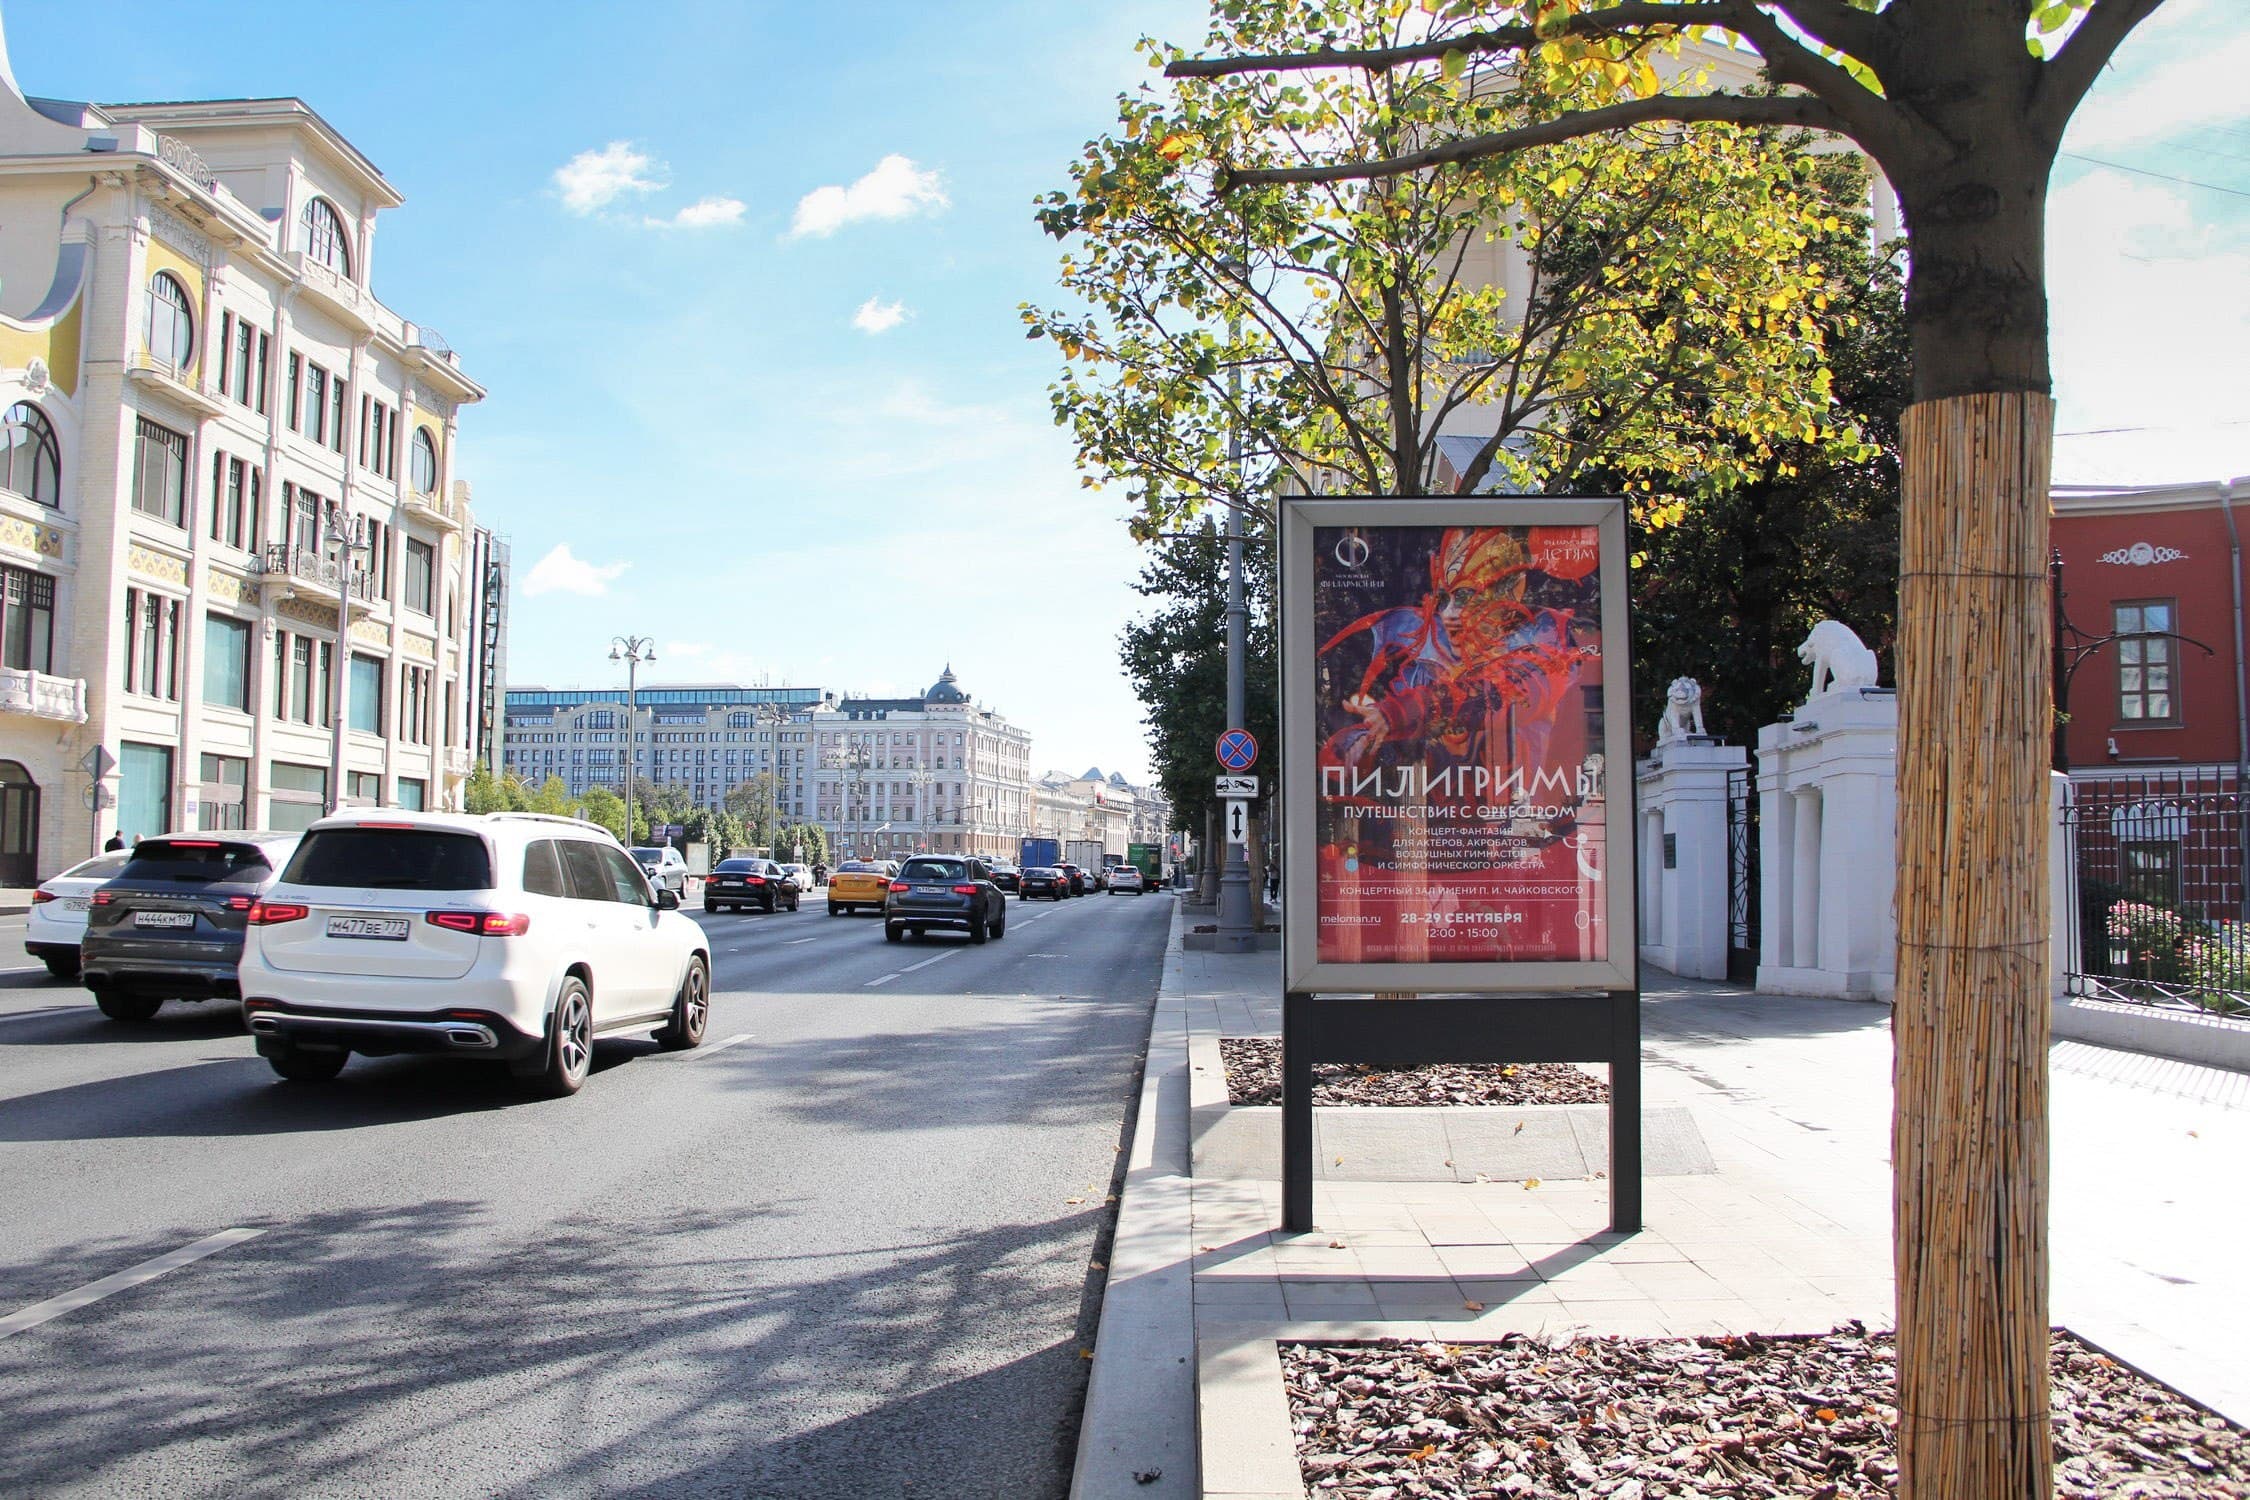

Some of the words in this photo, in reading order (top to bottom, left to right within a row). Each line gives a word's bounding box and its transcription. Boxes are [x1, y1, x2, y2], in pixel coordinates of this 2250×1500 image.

[1322, 765, 1598, 797] ПИЛИГРИМЫ
[1344, 805, 1456, 819] ПУТЕШЕСТВИЕ
[1460, 805, 1472, 818] С
[1476, 804, 1576, 818] ОРКЕСТРОМ
[1408, 827, 1513, 837] КОНЦЕРТ-ФАНТАЗИЯ
[1392, 838, 1415, 848] ДЛЯ
[1467, 838, 1528, 847] АКРОБАТОВ
[1396, 850, 1462, 859] ВОЗДУШНЫХ
[1464, 850, 1527, 858] ГИМНАСТОВ
[1377, 861, 1386, 870] И
[1387, 861, 1491, 870] СИМФОНИЧЕСКОГО
[1492, 861, 1546, 870] ОРКЕСТРА
[1339, 886, 1413, 896] КОНЦЕРТНЫЙ
[1415, 886, 1435, 895] ЗАЛ
[1438, 886, 1477, 895] ИМЕНИ
[1479, 886, 1489, 895] П.
[1491, 886, 1502, 895] И.
[1504, 885, 1584, 895] ЧАЙКОВСКОГО
[1320, 914, 1381, 923] meloman.ru
[1445, 912, 1522, 923] СЕНТЯБРЯ
[1425, 928, 1456, 938] 12:00
[1467, 928, 1498, 938] 15:00
